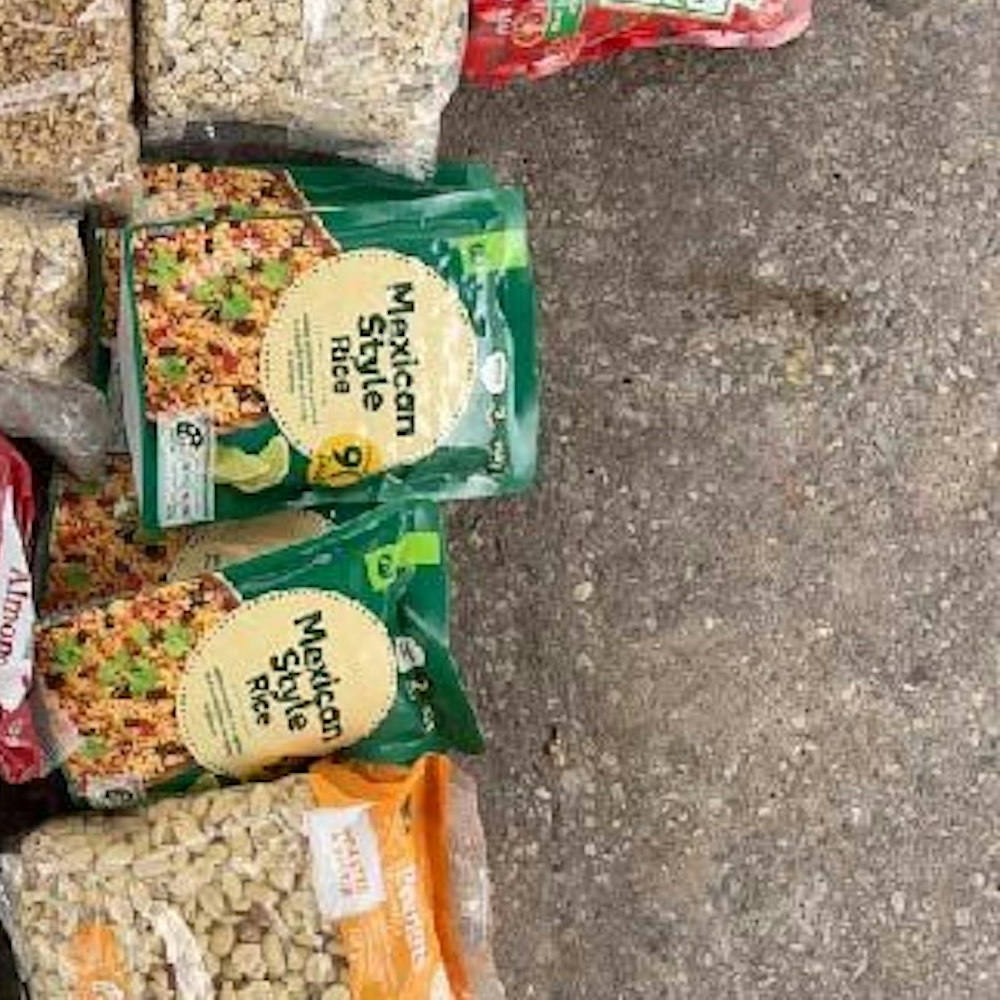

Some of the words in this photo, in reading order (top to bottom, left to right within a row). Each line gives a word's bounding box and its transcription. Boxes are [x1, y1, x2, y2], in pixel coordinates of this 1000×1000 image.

[331, 335, 355, 395] Rice
[353, 313, 388, 412] Style
[386, 282, 417, 437] Mexican
[246, 674, 271, 726] Rice
[270, 649, 309, 732] Style
[294, 610, 342, 742] Mexican
